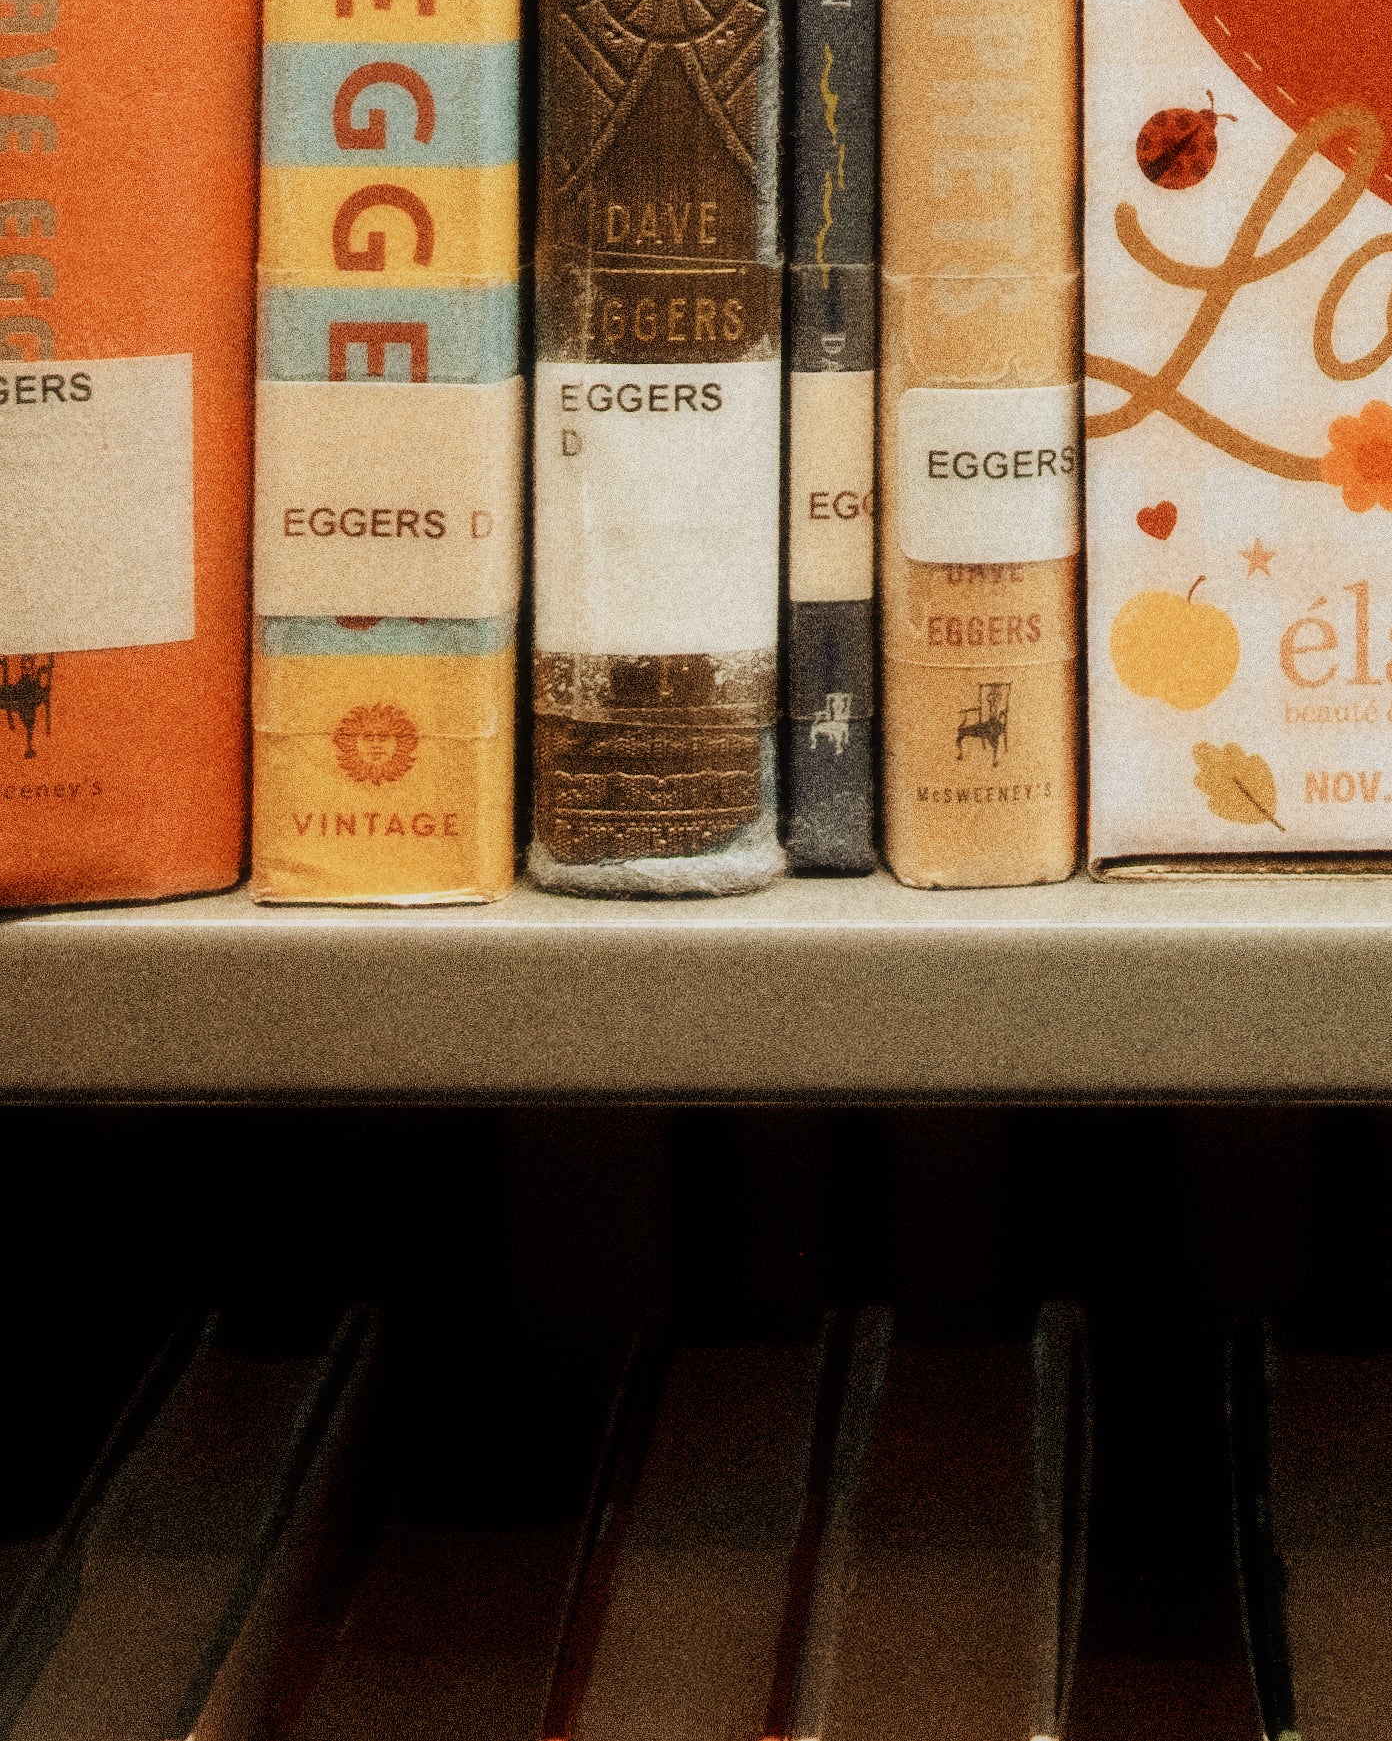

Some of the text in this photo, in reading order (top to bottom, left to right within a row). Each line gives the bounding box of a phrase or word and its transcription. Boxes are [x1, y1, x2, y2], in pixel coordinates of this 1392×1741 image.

[605, 199, 719, 249] DAVE
[0, 197, 57, 362] EGG
[0, 371, 92, 405] ERS
[560, 381, 724, 414] EGGERS
[560, 428, 585, 459] D
[927, 446, 1076, 481] EGGERS
[282, 507, 494, 540] EGGERS D
[1303, 769, 1392, 804] NOV.
[292, 812, 462, 840] VINTAGE
